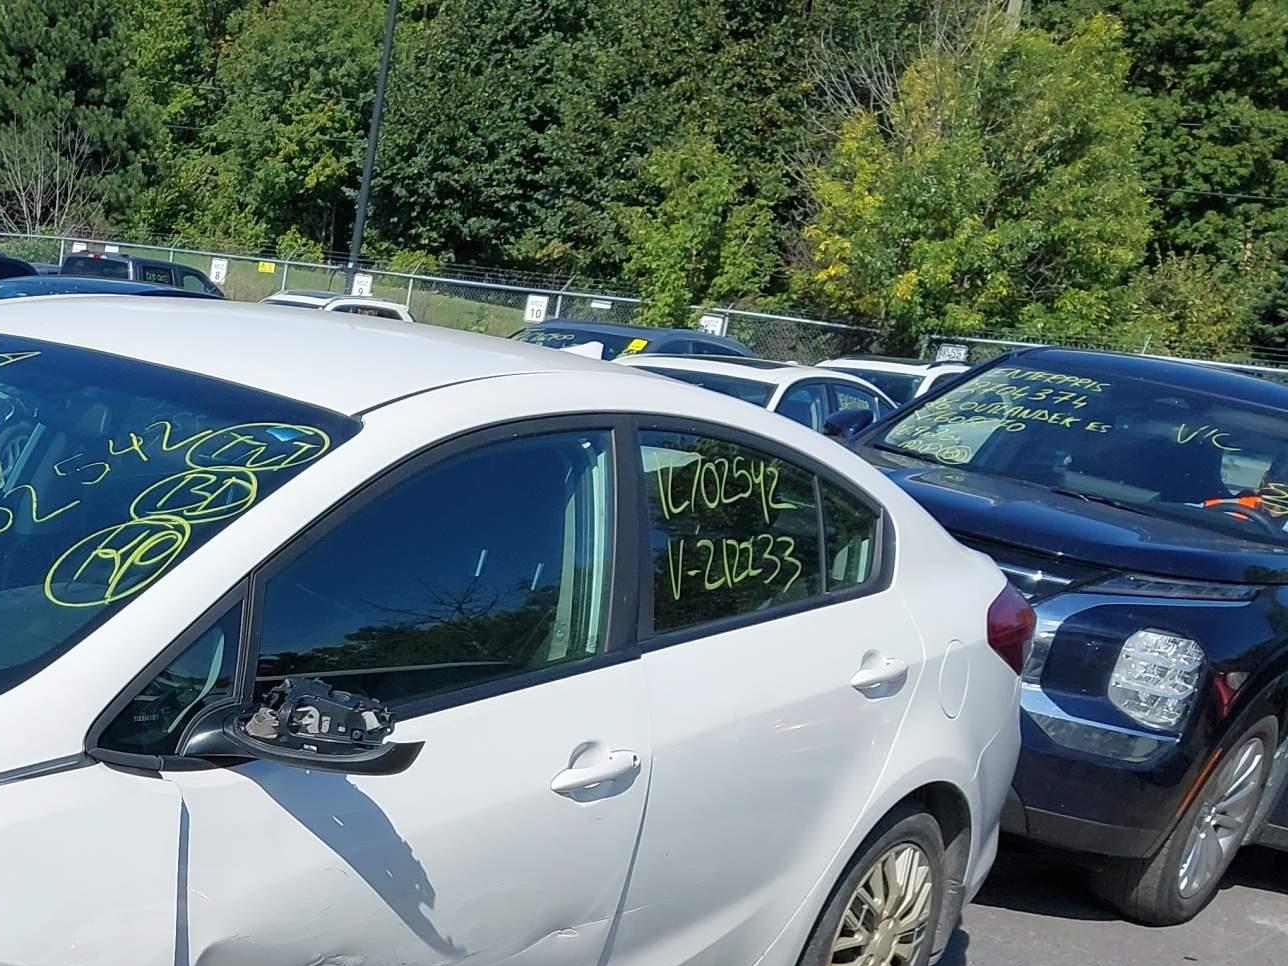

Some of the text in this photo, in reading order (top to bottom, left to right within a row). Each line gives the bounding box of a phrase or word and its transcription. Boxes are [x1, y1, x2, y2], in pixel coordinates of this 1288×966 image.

[530, 308, 543, 319] 10
[655, 450, 799, 525] 12702542
[667, 533, 803, 601] V-212233
